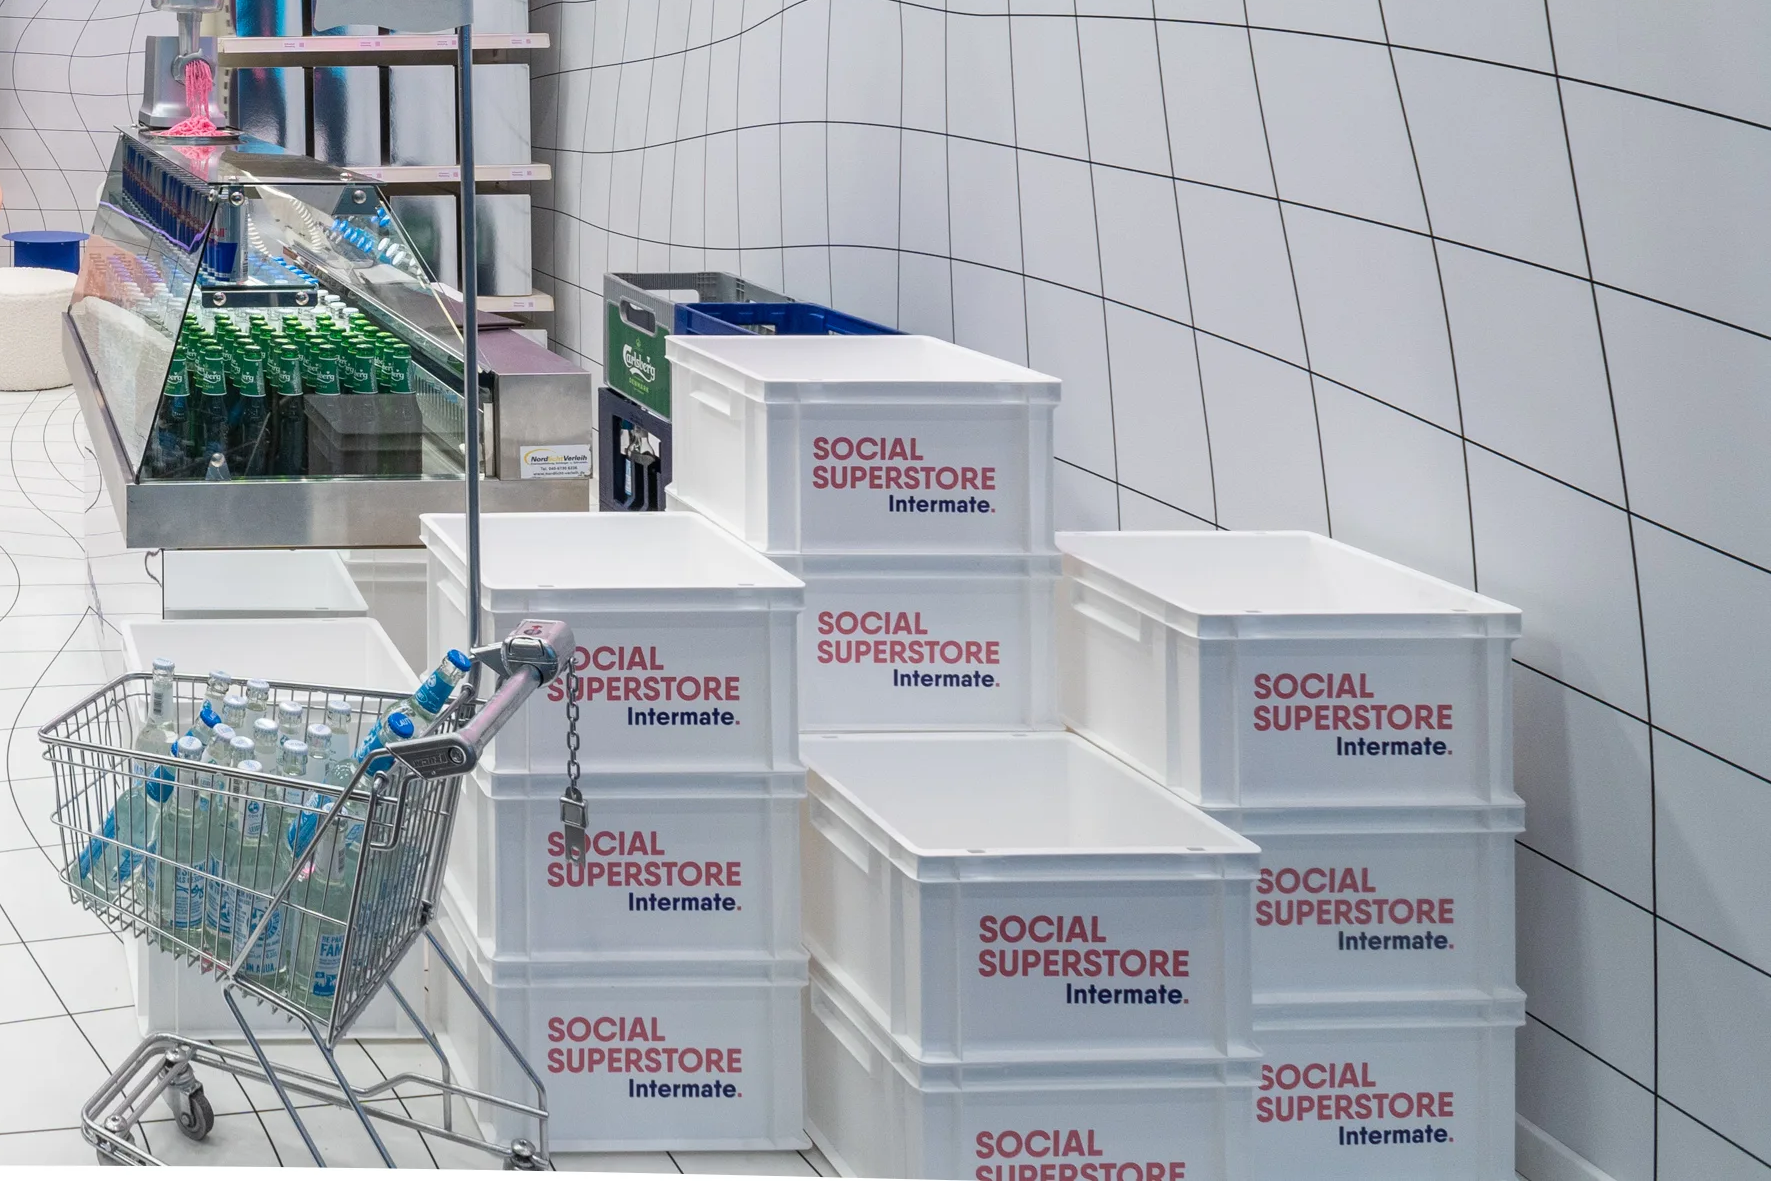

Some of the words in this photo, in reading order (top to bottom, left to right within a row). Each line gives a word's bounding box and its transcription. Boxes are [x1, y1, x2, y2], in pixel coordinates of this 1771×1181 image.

[623, 344, 656, 382] Carlsberg
[813, 437, 923, 461] SOCIAL
[813, 466, 996, 490] SUPERSTORE
[889, 495, 996, 513] Intermate.
[818, 611, 928, 635] SOCIAL
[576, 646, 664, 671] OCIAL
[817, 641, 1000, 664] SUPERSTORE
[548, 676, 740, 702] SUPERSTORE
[893, 668, 1000, 687] Intermate.
[1254, 673, 1374, 699] SOCIAL
[628, 707, 741, 726] Intermate.
[1254, 704, 1453, 731] SUPERSTORE
[1336, 736, 1454, 757] Intermate.
[548, 831, 665, 857] SCIAL
[548, 861, 742, 887] SUPERSTORE
[1256, 868, 1375, 894] SOCIAL
[628, 892, 742, 912] Intermate.
[1256, 899, 1454, 926] SUPERSTORE
[979, 915, 1106, 943] SOCIAL
[1338, 930, 1455, 951] Intermate.
[978, 949, 1189, 977] SUPERSTORE
[1066, 983, 1190, 1005] Intermate.
[548, 1016, 665, 1042] SOCIAL
[548, 1047, 742, 1073] SUPERSTORE
[628, 1078, 742, 1099] Intermate.
[1260, 1063, 1375, 1091] SOCIAL
[1256, 1092, 1454, 1123] SUPERSTORE
[975, 1129, 1103, 1159] SOCIAL
[1338, 1124, 1454, 1146] Intermate.
